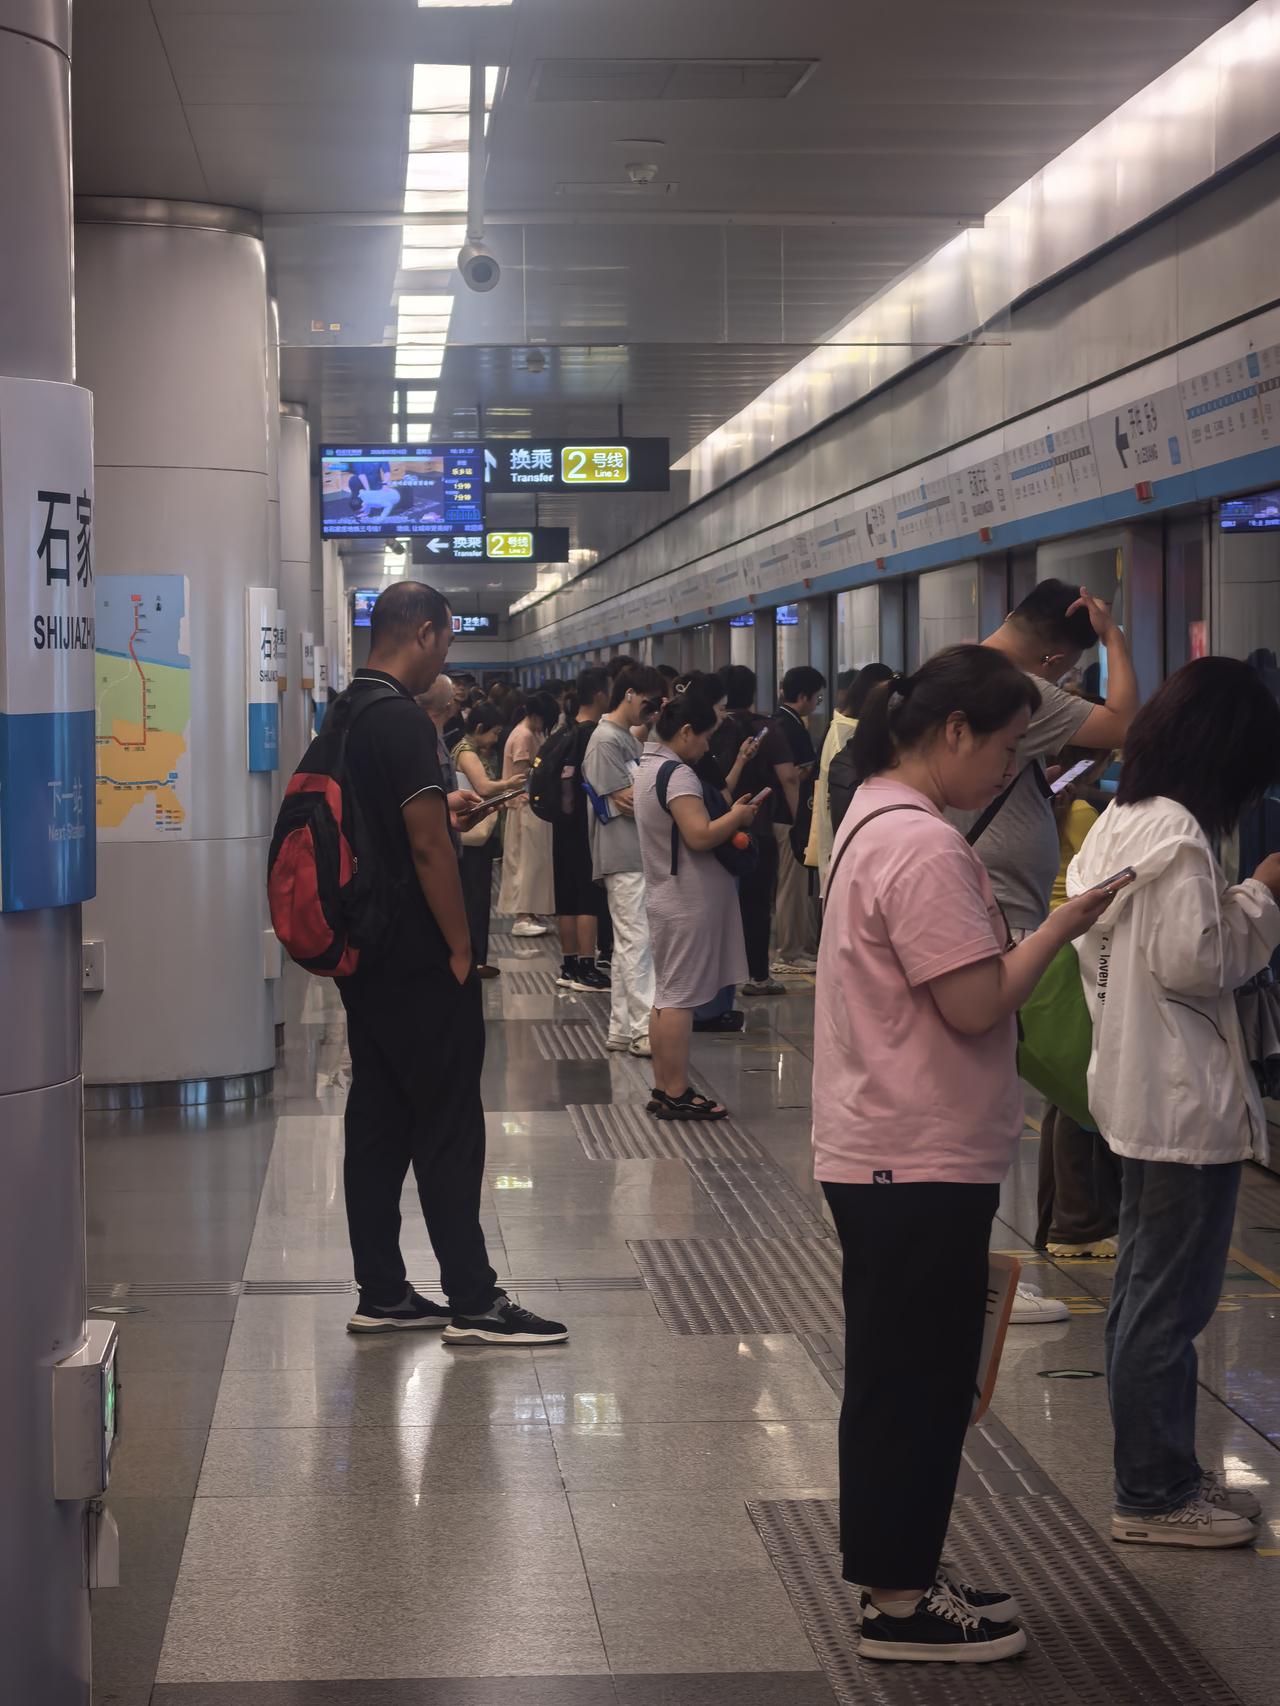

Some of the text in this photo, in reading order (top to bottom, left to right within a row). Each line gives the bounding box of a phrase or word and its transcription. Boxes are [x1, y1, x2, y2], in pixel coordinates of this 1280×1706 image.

[509, 448, 553, 470] 换乘
[567, 451, 624, 479] 2 号线
[510, 473, 554, 483] Transfer
[594, 469, 619, 478] Line 2
[37, 488, 93, 588] 石家
[452, 537, 482, 549] 换乘
[491, 535, 529, 555] 2 号线
